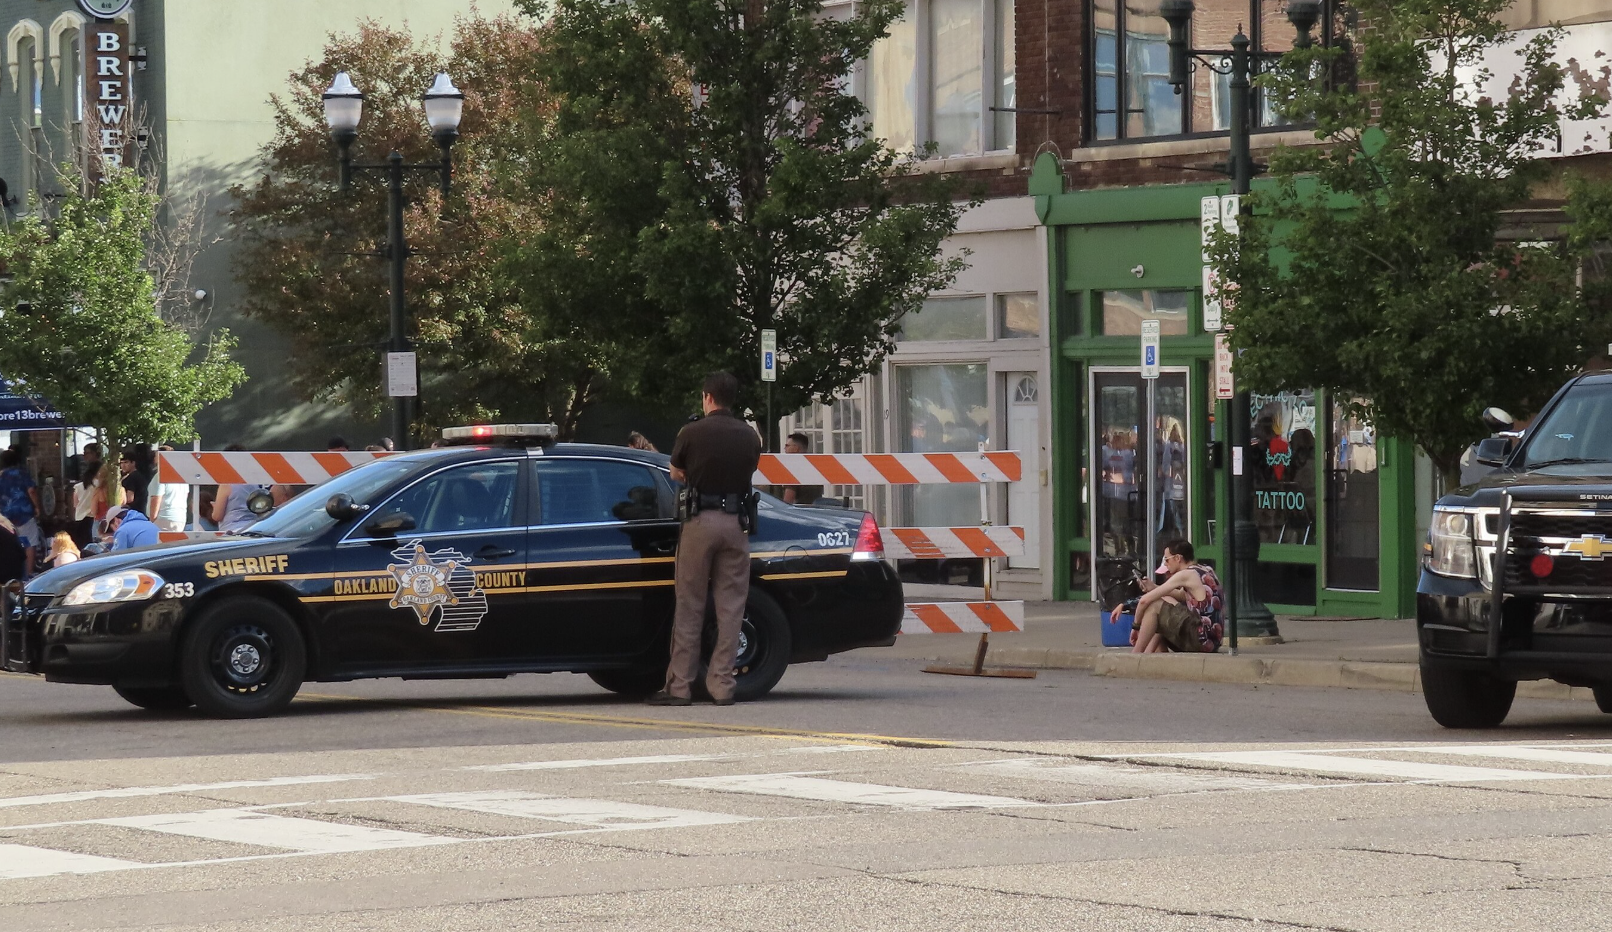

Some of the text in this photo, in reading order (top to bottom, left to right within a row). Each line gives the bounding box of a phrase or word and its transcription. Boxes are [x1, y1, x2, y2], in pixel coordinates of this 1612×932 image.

[1204, 203, 1208, 215] 2
[1256, 491, 1305, 510] TATTOO
[817, 531, 850, 547] 0627
[204, 555, 289, 578] SHERIFF
[406, 565, 441, 578] SHERIFF
[164, 582, 194, 599] 353
[334, 570, 527, 595] OAKLAND COUNTY
